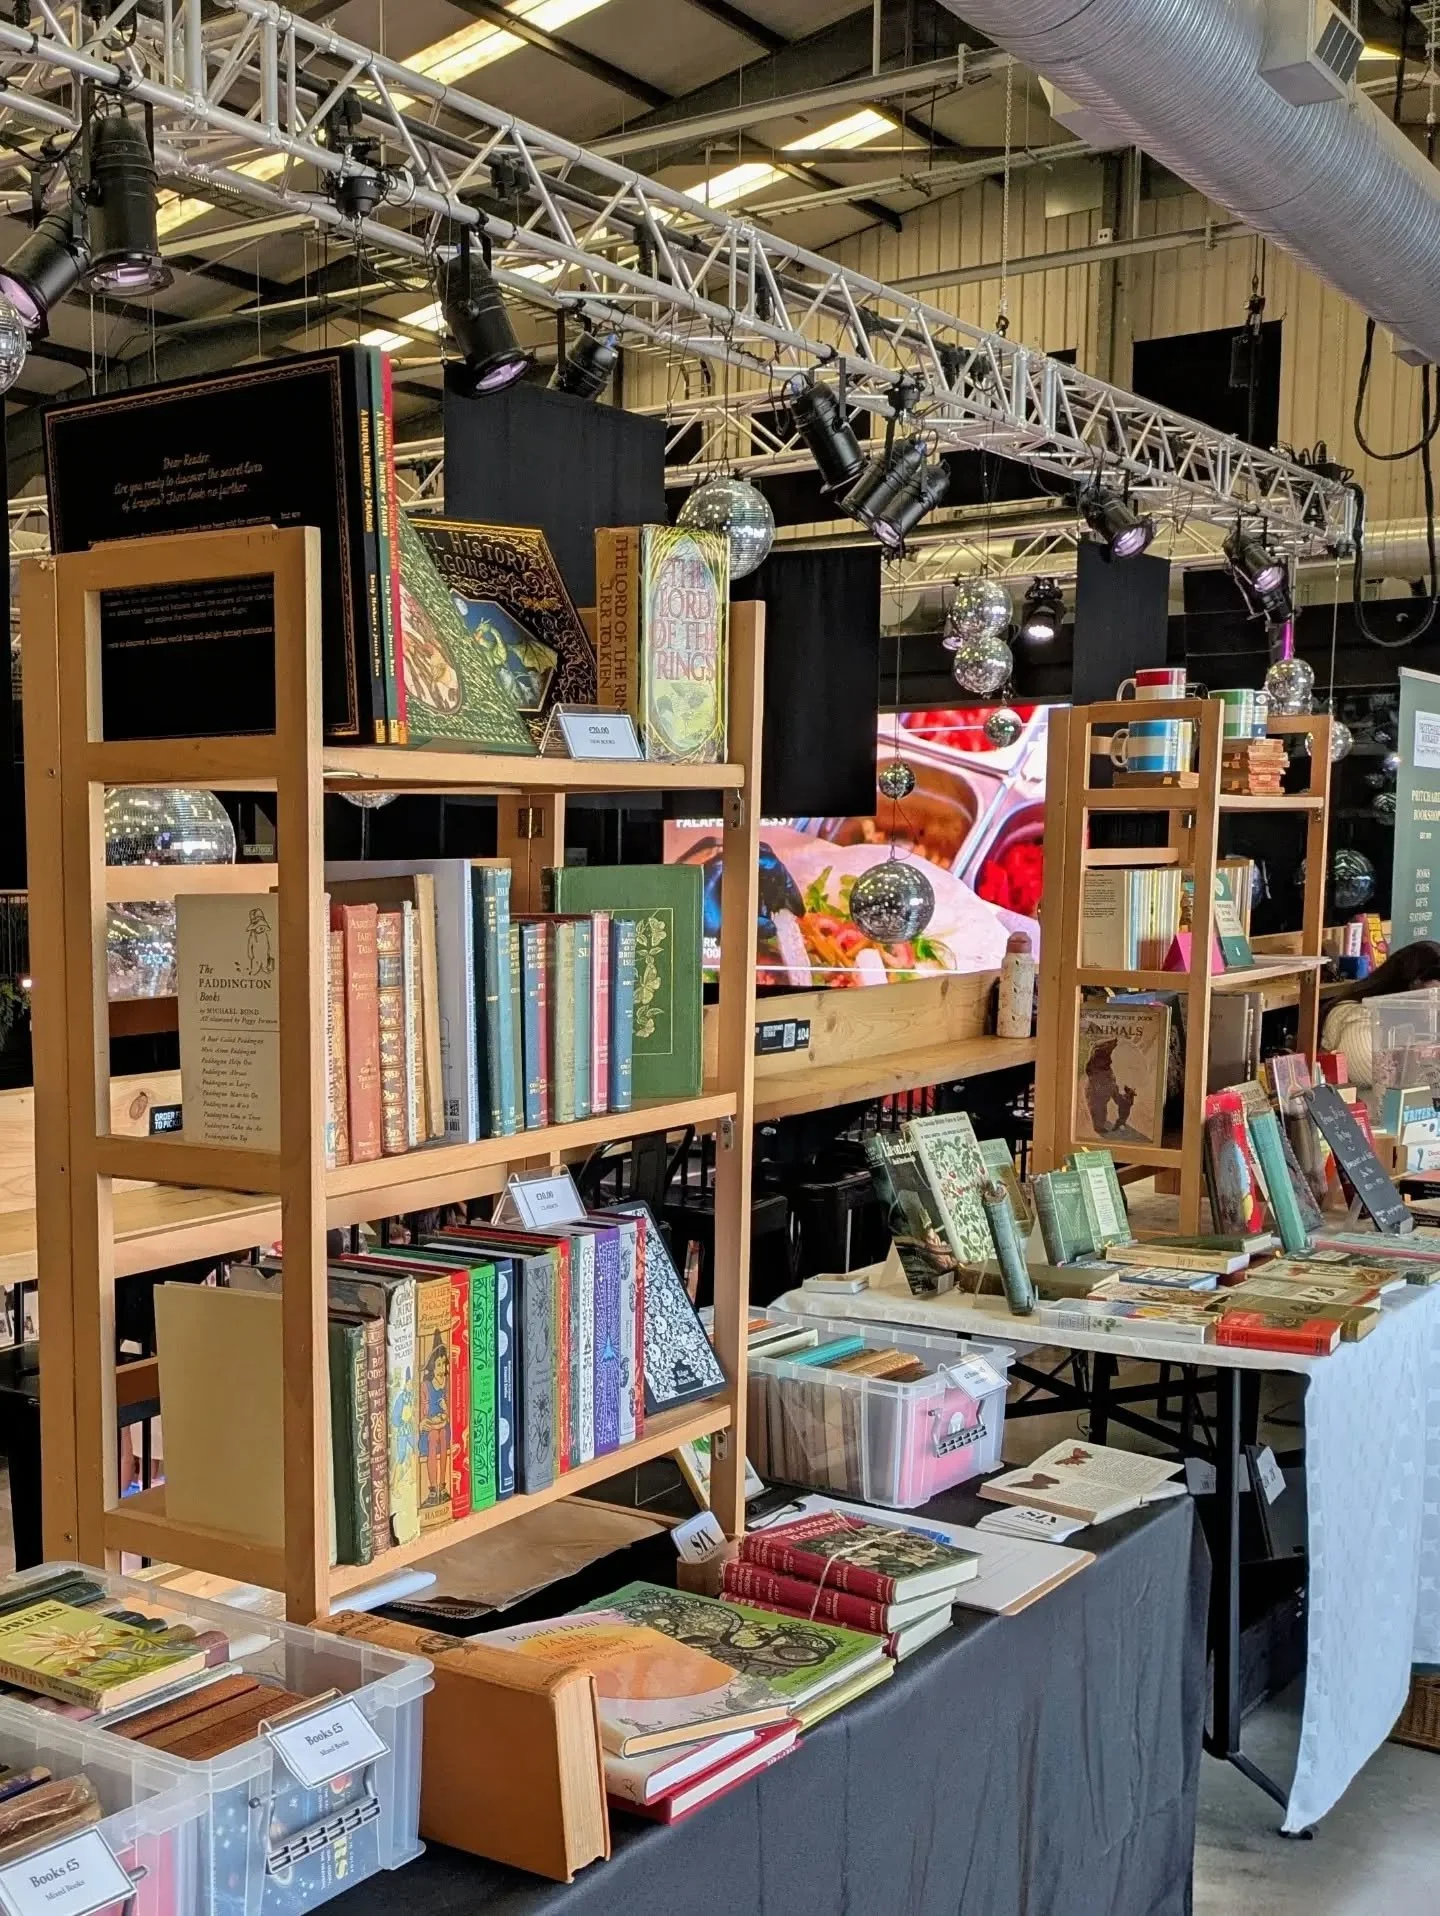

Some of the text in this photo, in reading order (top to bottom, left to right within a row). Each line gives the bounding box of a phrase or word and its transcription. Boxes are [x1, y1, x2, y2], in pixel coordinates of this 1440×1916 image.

[361, 416, 370, 454] NATURAL
[376, 419, 385, 456] NATURAL
[129, 484, 143, 497] you
[175, 471, 207, 485] discover
[208, 467, 220, 479] the
[363, 454, 372, 492] HISTORY
[378, 461, 387, 494] HISTORY
[381, 505, 389, 537] FAIRIES
[448, 531, 527, 572] HISTORY
[615, 535, 628, 575] THE
[433, 553, 489, 579] AGONS
[662, 558, 706, 588] THE
[614, 574, 628, 618] LORD
[659, 589, 712, 619] LORD
[614, 621, 628, 643] OF
[650, 621, 718, 651] OF THE
[600, 623, 613, 689] TOLKIEN
[614, 647, 628, 682] THE
[655, 651, 717, 682] RINGS
[199, 963, 215, 976] The
[198, 978, 273, 990] PADDINGTON
[199, 990, 221, 1003] Books
[206, 1007, 238, 1015] MICHAEL
[239, 1008, 260, 1016] BOND
[237, 1036, 264, 1046] Paddington
[797, 1027, 810, 1041] 104
[1085, 1023, 1144, 1037] ANIMALS
[201, 1057, 227, 1066] Paddington
[230, 1048, 257, 1057] Paddington
[202, 1068, 227, 1077] Paddington
[202, 1079, 228, 1087] Paddington
[202, 1089, 228, 1099] Paddington
[202, 1101, 228, 1109] Paddington
[154, 1111, 175, 1122] ORDER
[154, 1121, 163, 1129] TO
[203, 1111, 229, 1120] Paddington
[420, 1285, 450, 1299] MOTHER
[421, 1298, 450, 1311] GOOSE
[690, 1527, 716, 1557] SIX
[0, 1607, 63, 1633] OWERS
[506, 1619, 600, 1643] Roald Dahl
[539, 1630, 598, 1649] JAMES
[304, 1722, 344, 1746] Books £5
[320, 1739, 350, 1757] Mixed Books
[29, 1857, 80, 1888] Books £5
[45, 1879, 86, 1901] Mixed Books
